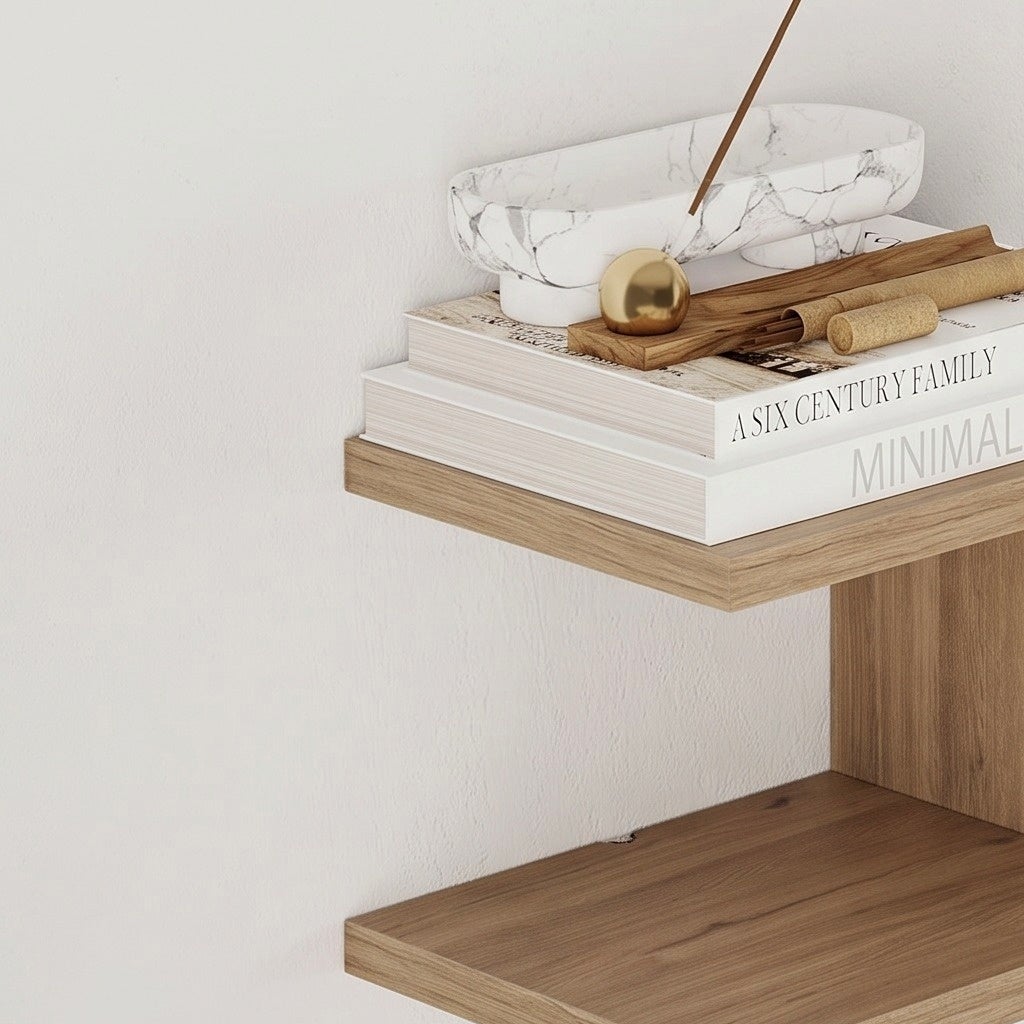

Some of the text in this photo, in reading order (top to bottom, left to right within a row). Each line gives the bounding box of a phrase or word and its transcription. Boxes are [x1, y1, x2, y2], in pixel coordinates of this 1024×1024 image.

[732, 346, 997, 442] A SIX CENTURY FAMILY
